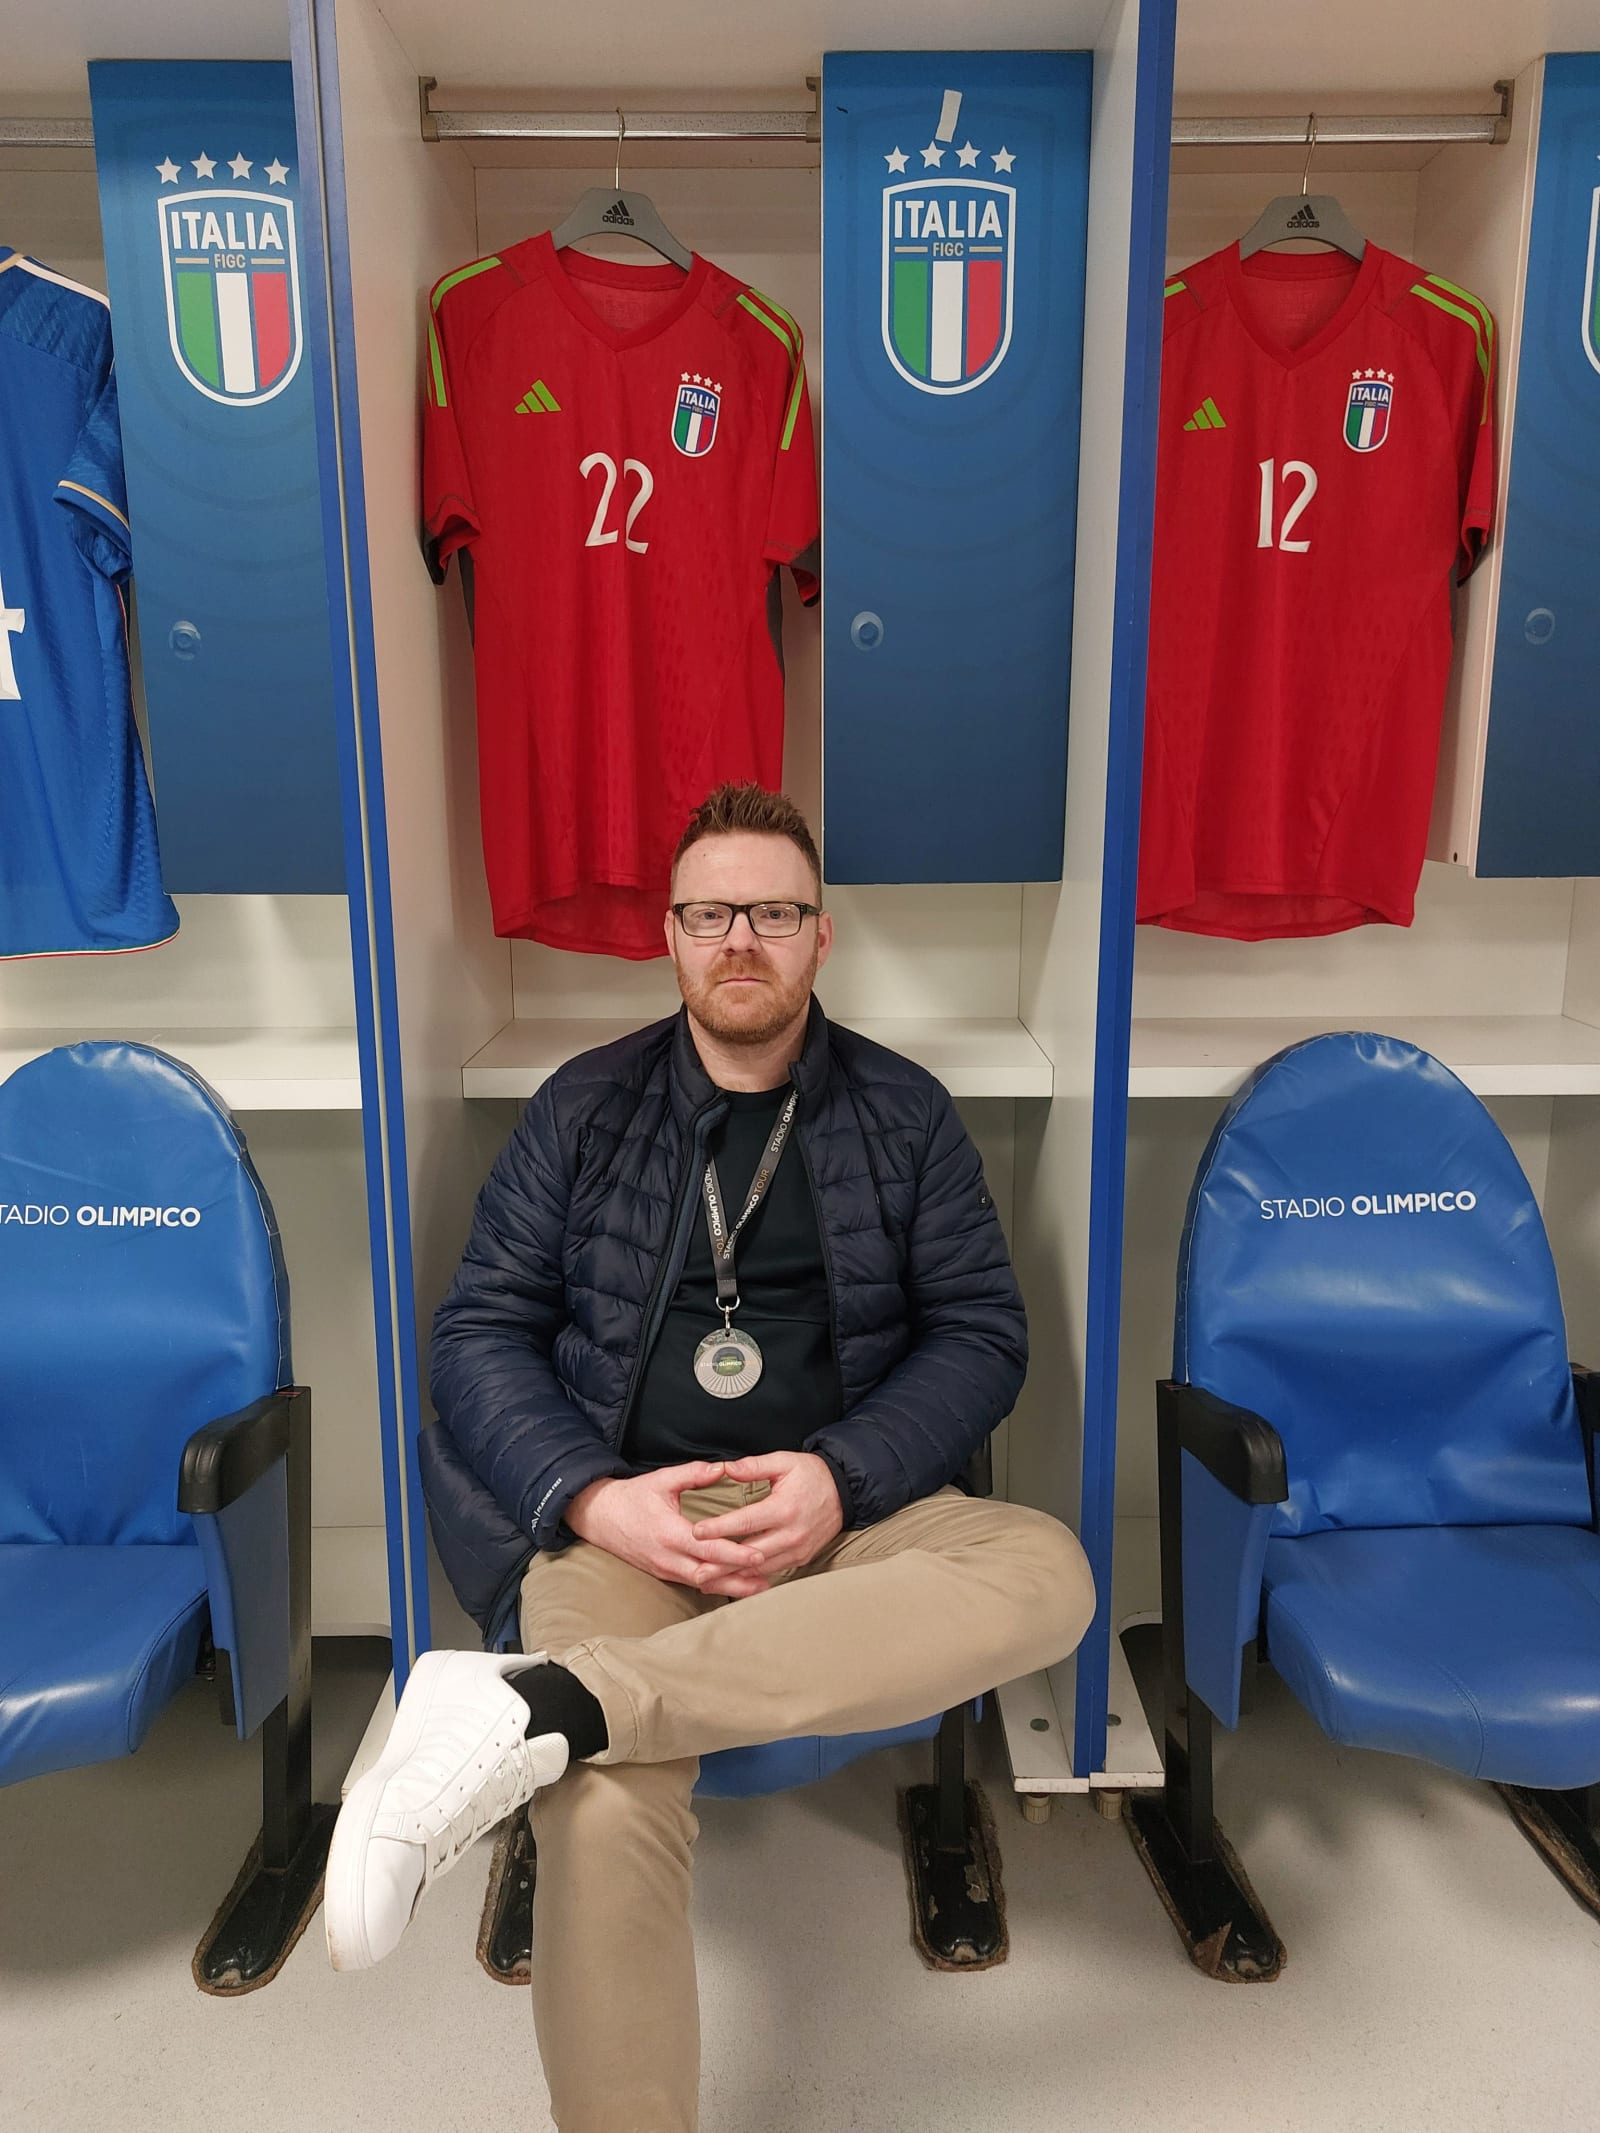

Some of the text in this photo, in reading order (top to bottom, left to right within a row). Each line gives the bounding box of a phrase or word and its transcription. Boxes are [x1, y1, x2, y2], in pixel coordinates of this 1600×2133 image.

[170, 211, 284, 250] ITALIA
[602, 214, 634, 226] adidas
[894, 200, 1003, 238] ITALIA
[1286, 219, 1320, 229] adidas
[213, 253, 246, 268] FIGC
[932, 242, 964, 257] FIGC
[680, 389, 716, 411] ITALIA
[1352, 387, 1389, 402] ITALIA
[579, 452, 654, 554] 22
[1257, 457, 1318, 553] 12
[771, 1088, 799, 1153] STADIO OLIMPIC
[0, 1204, 201, 1227] TADIO OLIMPICO
[723, 1168, 770, 1259] STADIO OLIMPICO TOUR
[1260, 1190, 1476, 1220] STADIO OLIMPICO
[708, 1194, 722, 1236] OLIMPICO
[715, 1236, 725, 1256] TO
